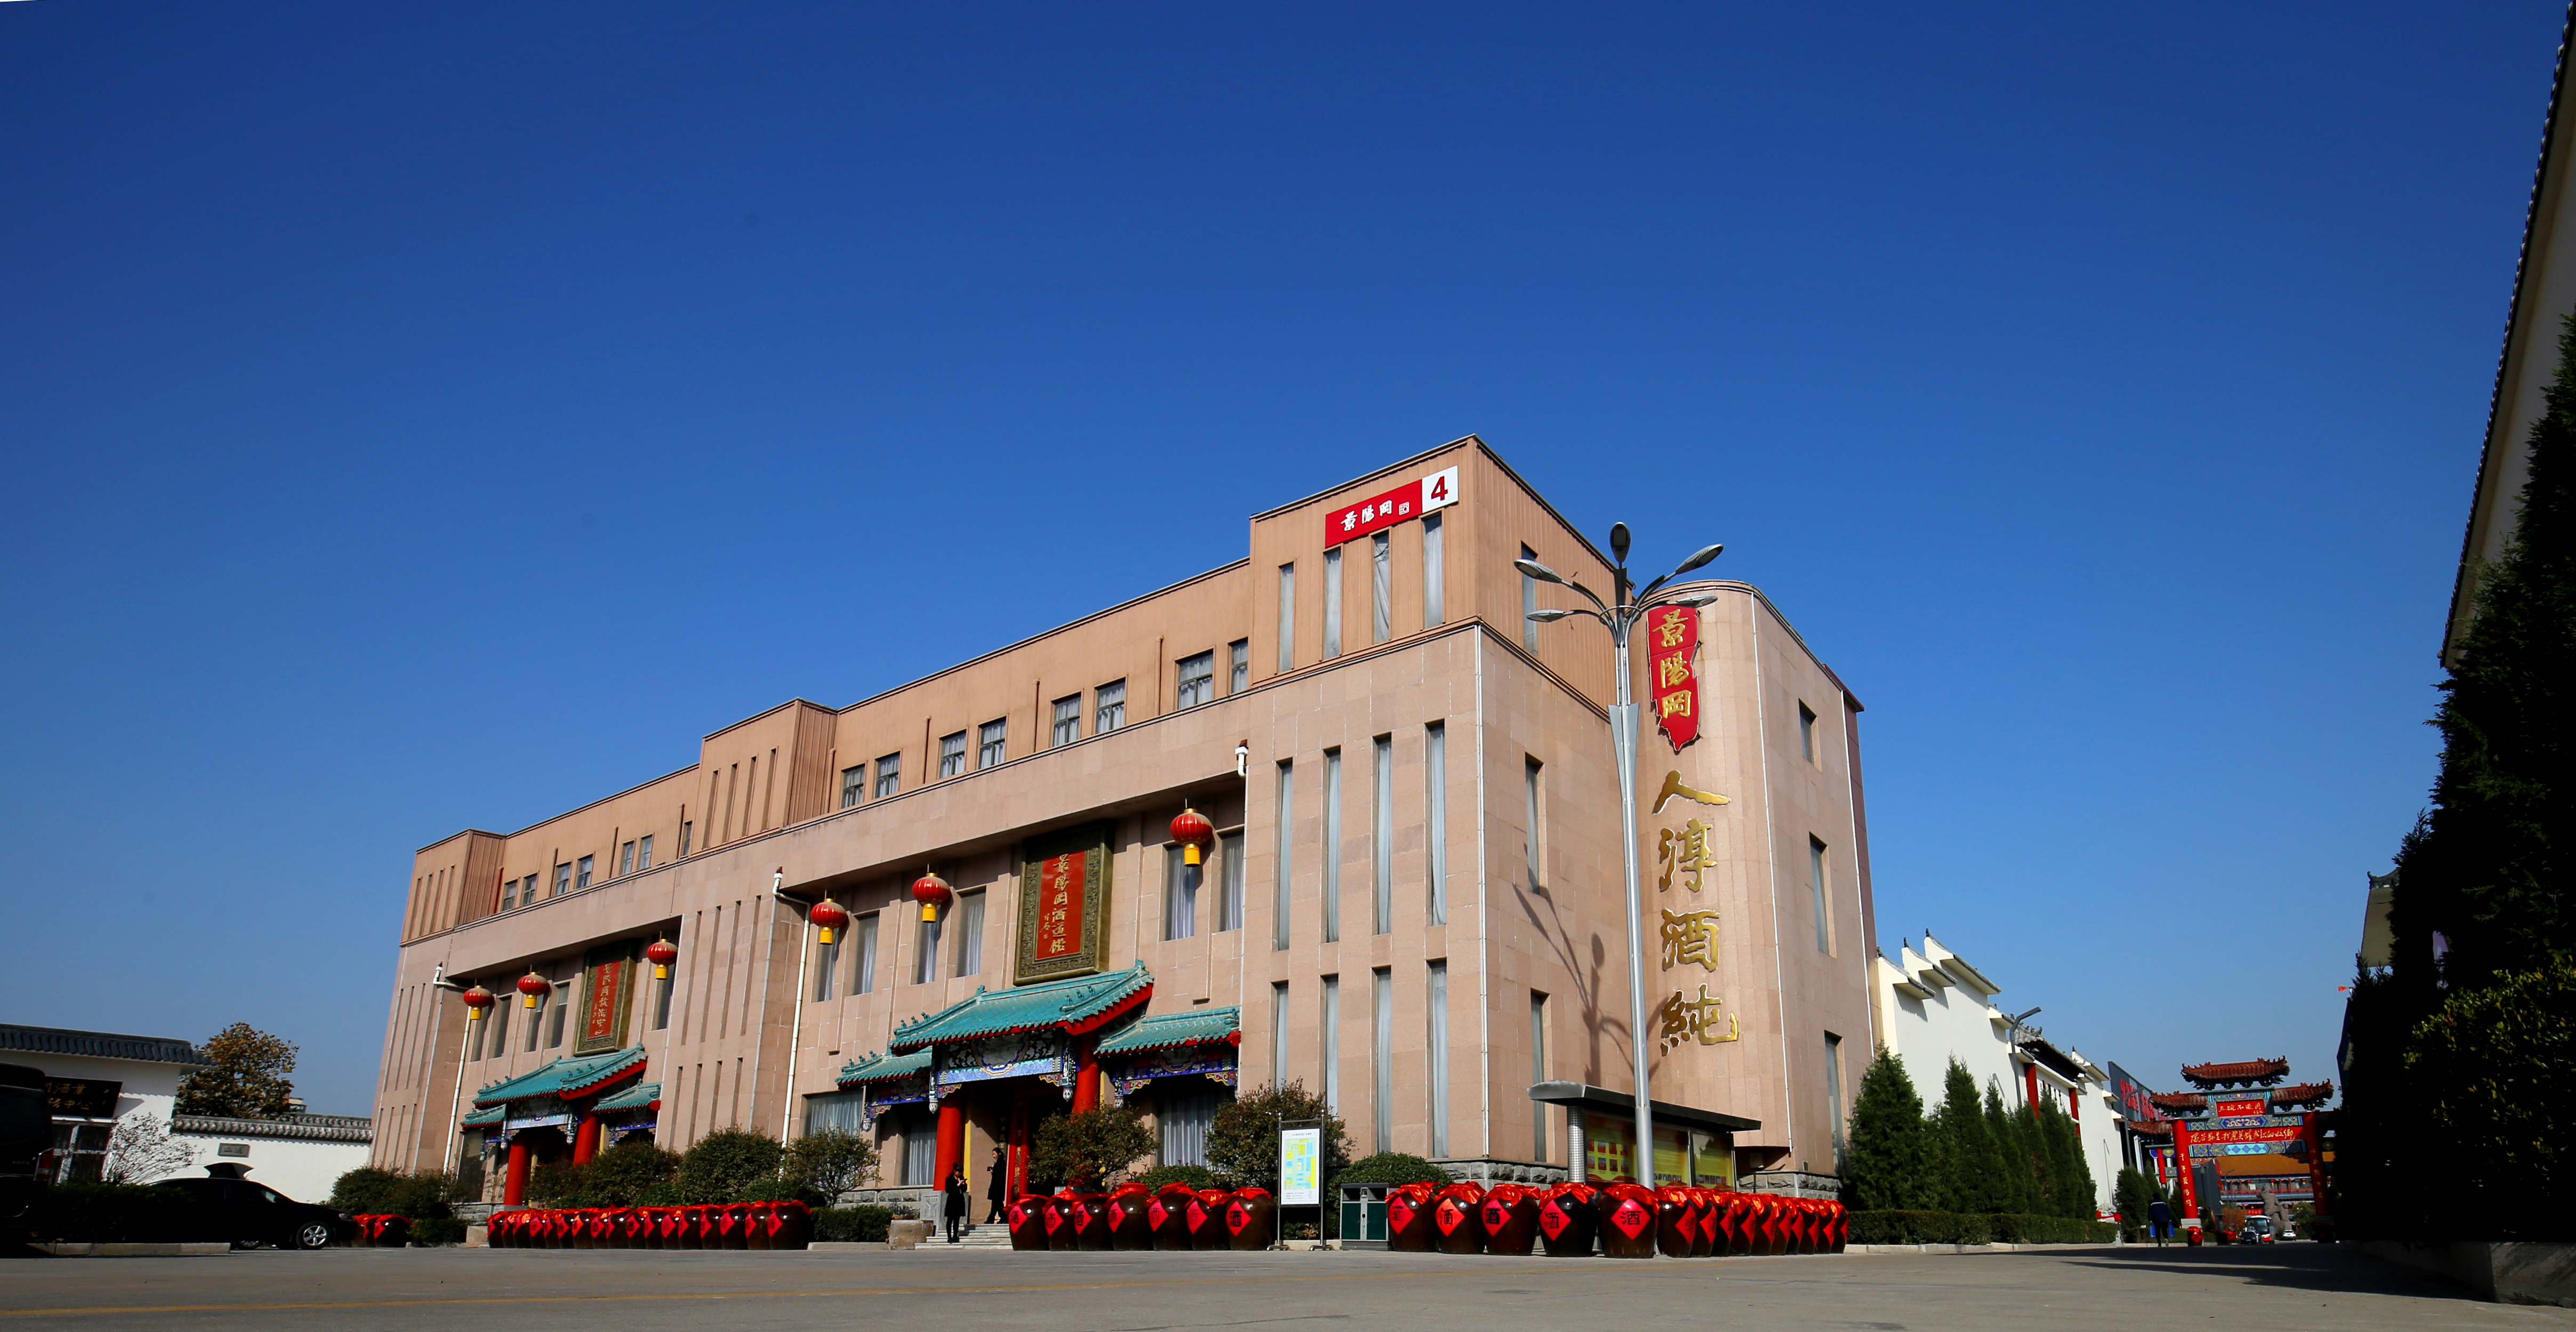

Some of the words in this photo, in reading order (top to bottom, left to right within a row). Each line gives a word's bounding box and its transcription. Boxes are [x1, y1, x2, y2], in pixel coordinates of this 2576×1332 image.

[1430, 475, 1448, 501] 4
[1229, 1210, 1242, 1227] 酒
[1485, 1208, 1501, 1225] 酒
[1544, 1211, 1559, 1229] 酒
[1620, 1210, 1642, 1225] 酒
